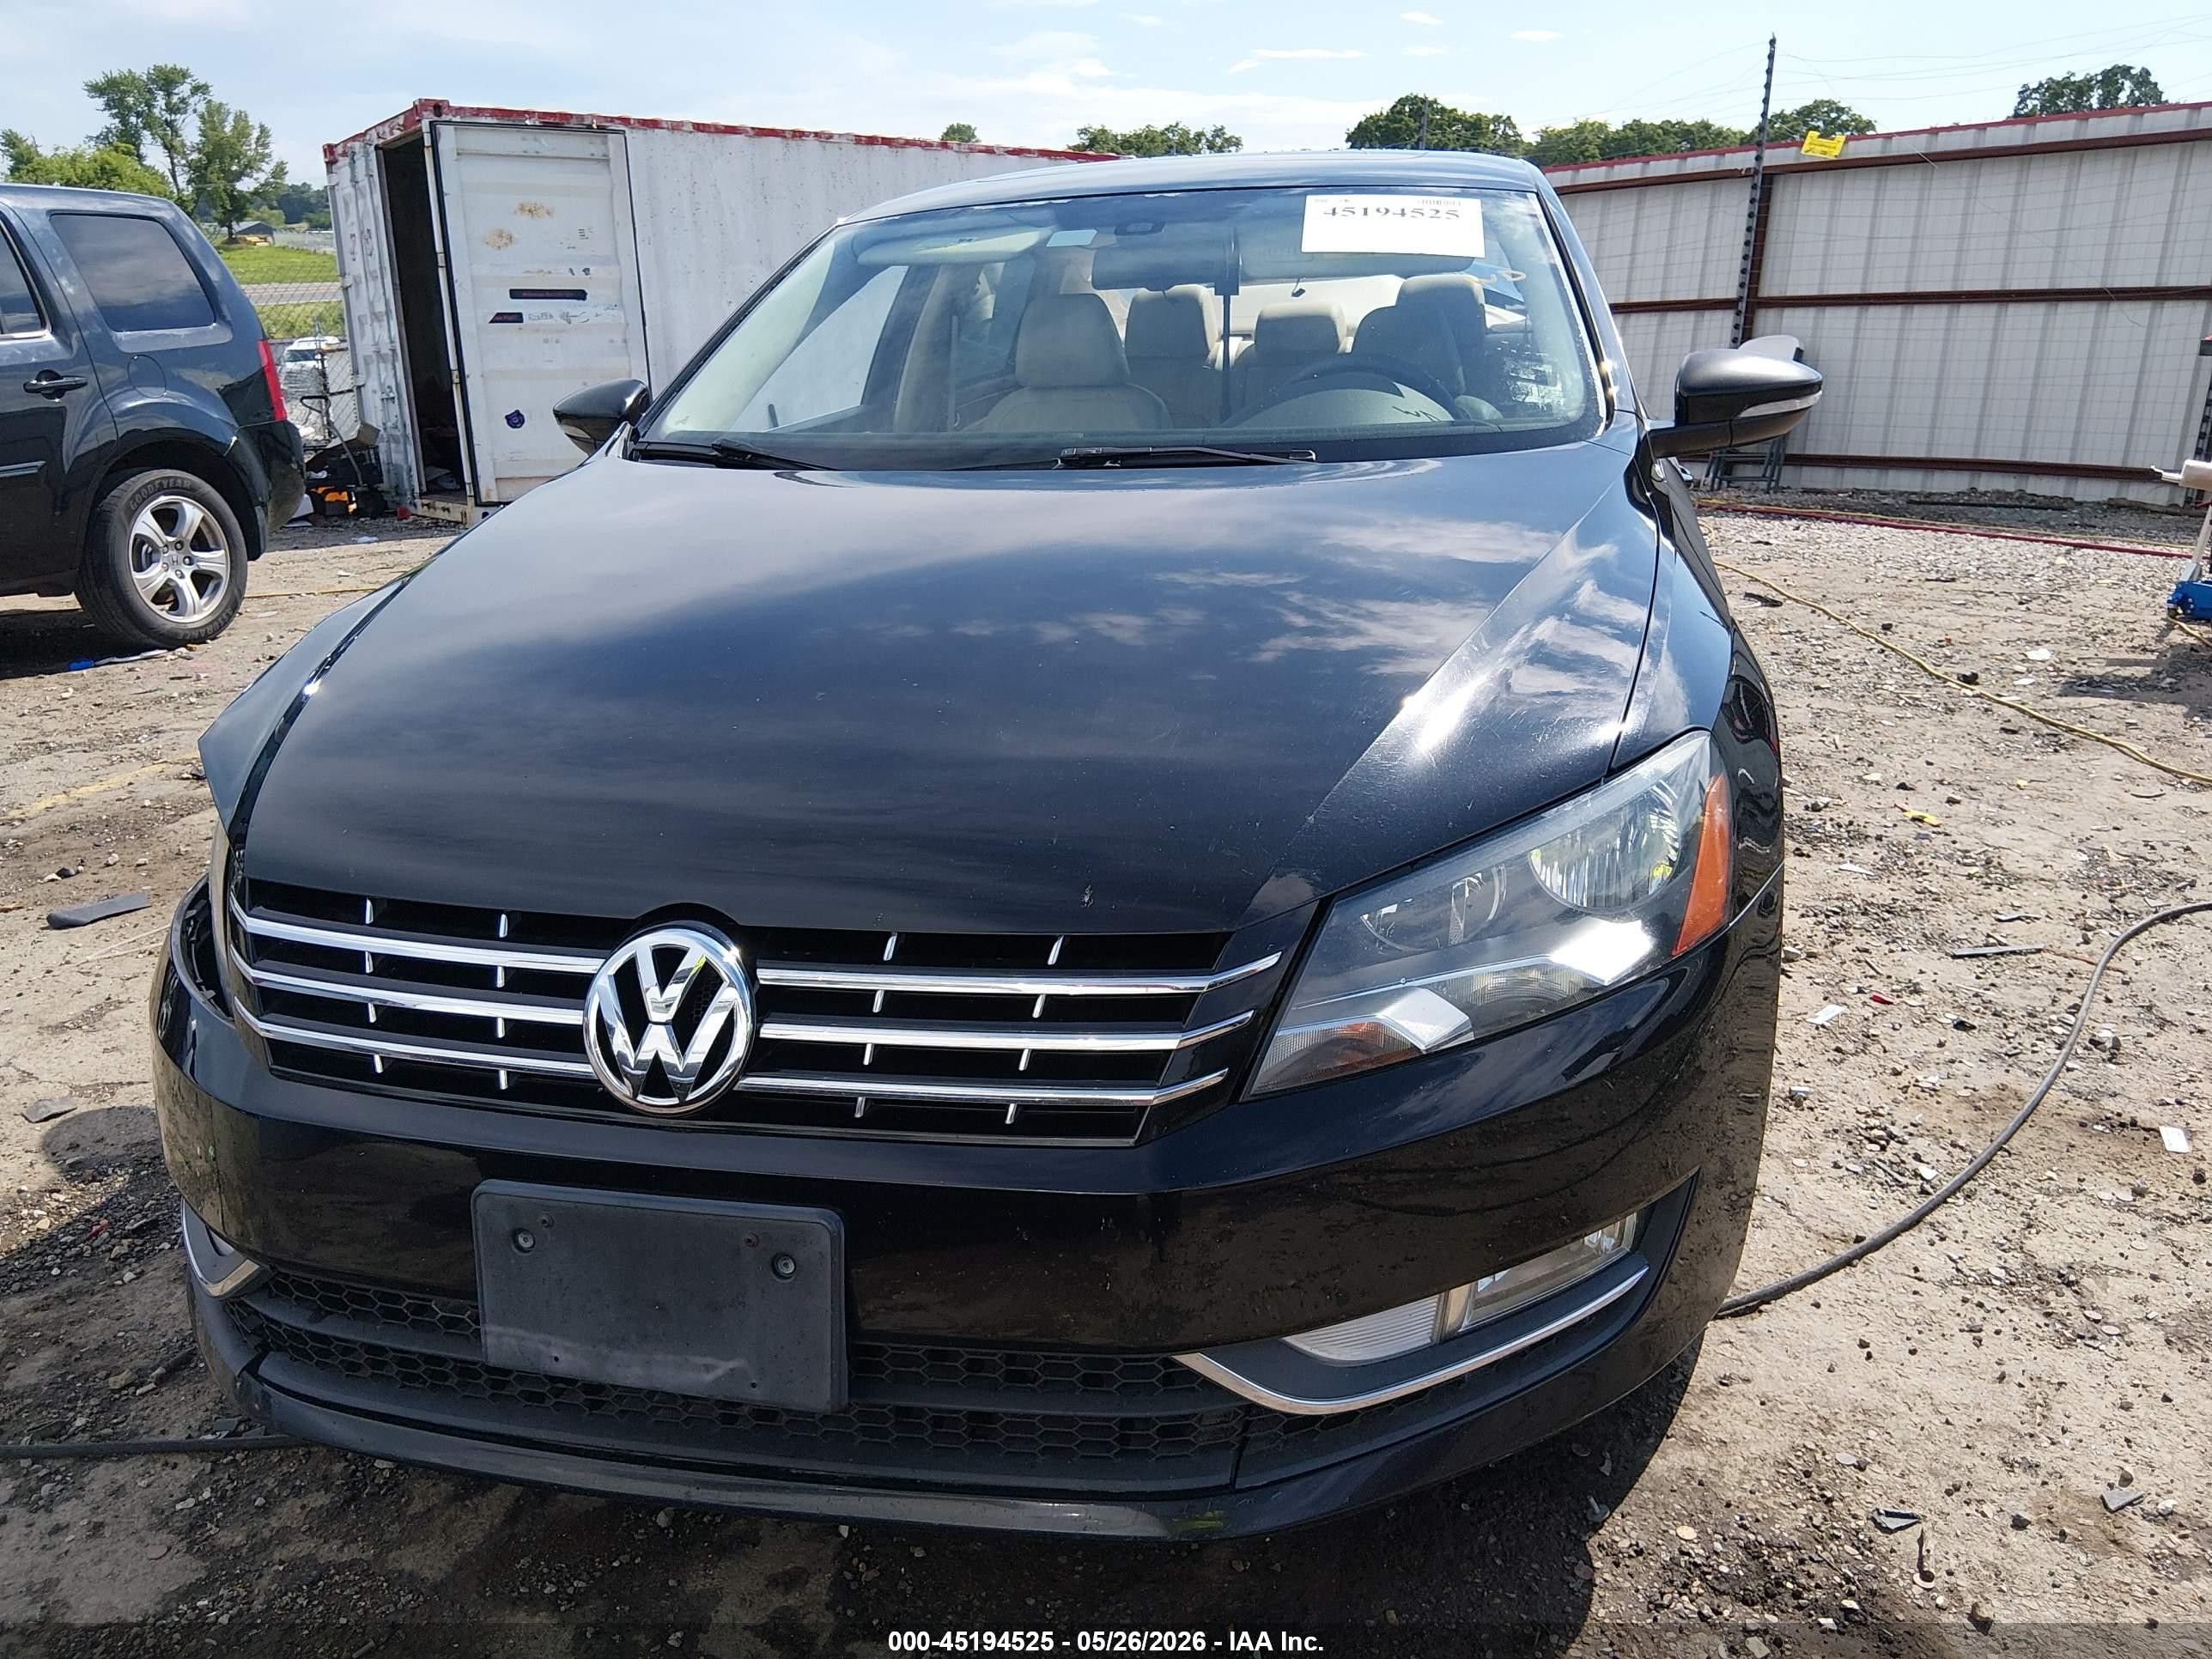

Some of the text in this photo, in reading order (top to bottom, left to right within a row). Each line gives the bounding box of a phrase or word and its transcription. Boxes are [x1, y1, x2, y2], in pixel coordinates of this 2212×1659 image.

[1323, 207, 1460, 220] 45194525
[130, 478, 191, 510] GOODYEAR
[591, 938, 747, 1107] VW
